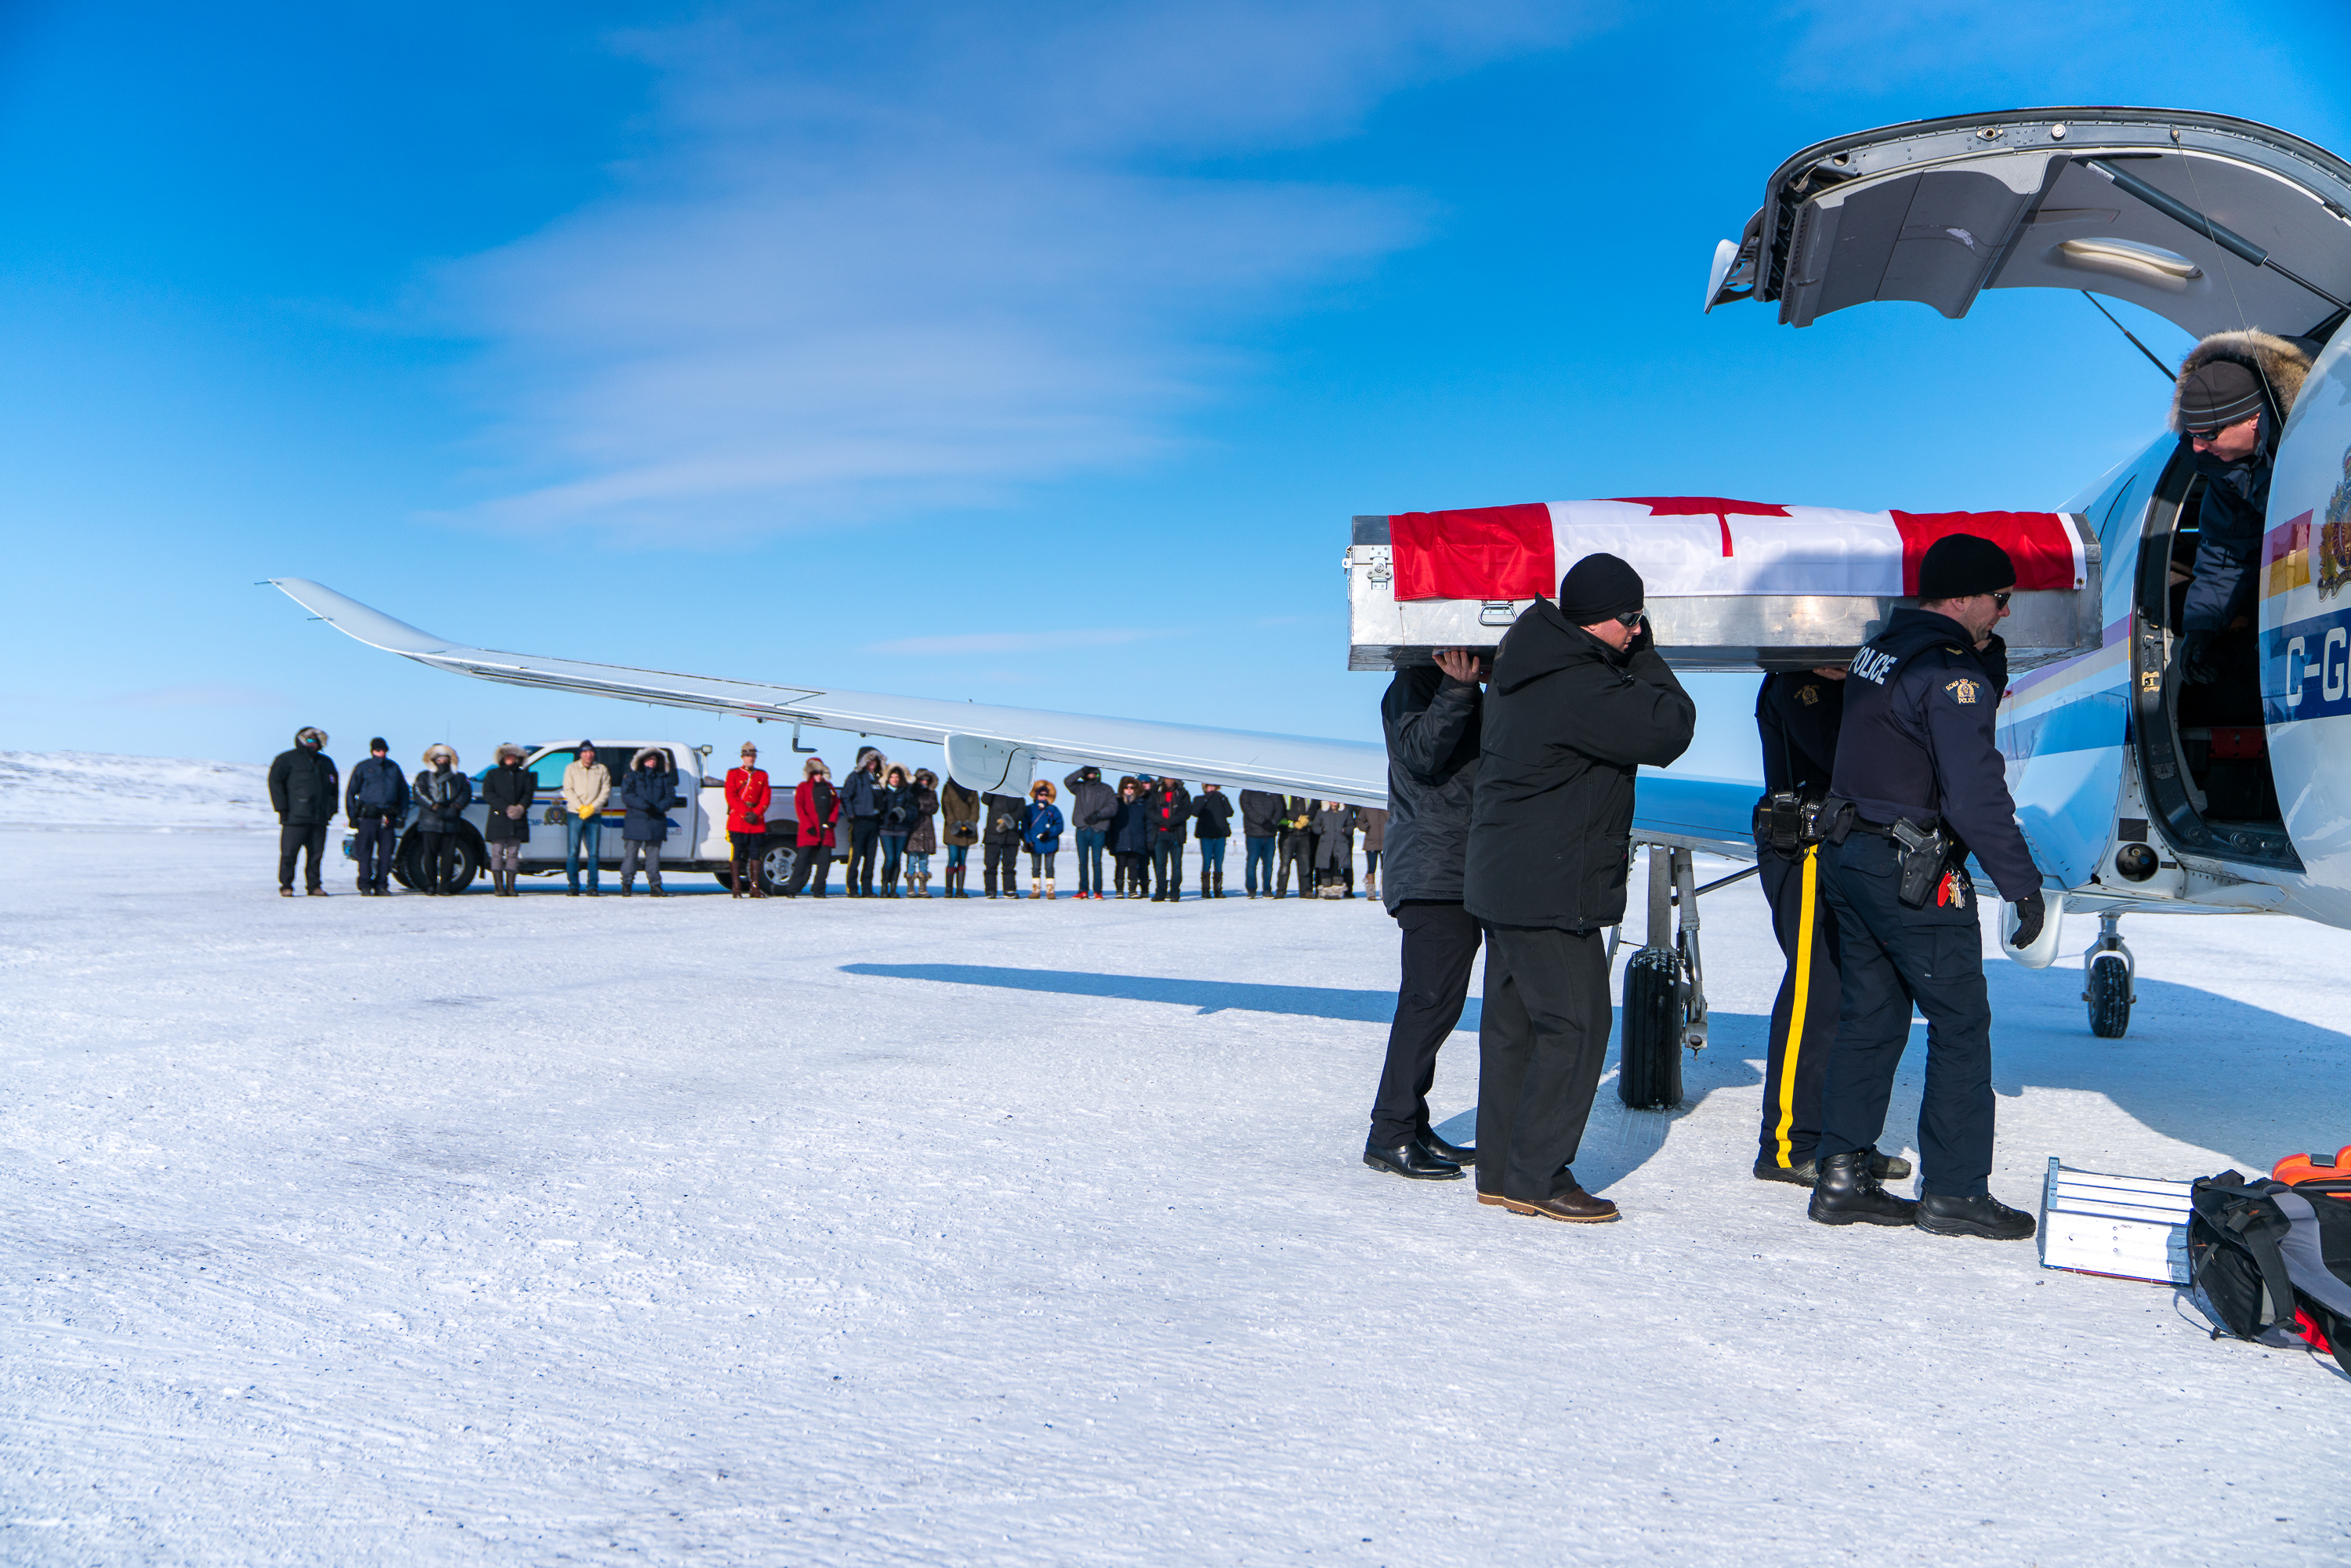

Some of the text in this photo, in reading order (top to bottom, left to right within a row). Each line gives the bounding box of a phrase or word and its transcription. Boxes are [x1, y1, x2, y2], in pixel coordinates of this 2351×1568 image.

[1848, 646, 1897, 685] POLICE
[2286, 626, 2351, 707] C-G
[1945, 680, 1959, 691] RCMP
